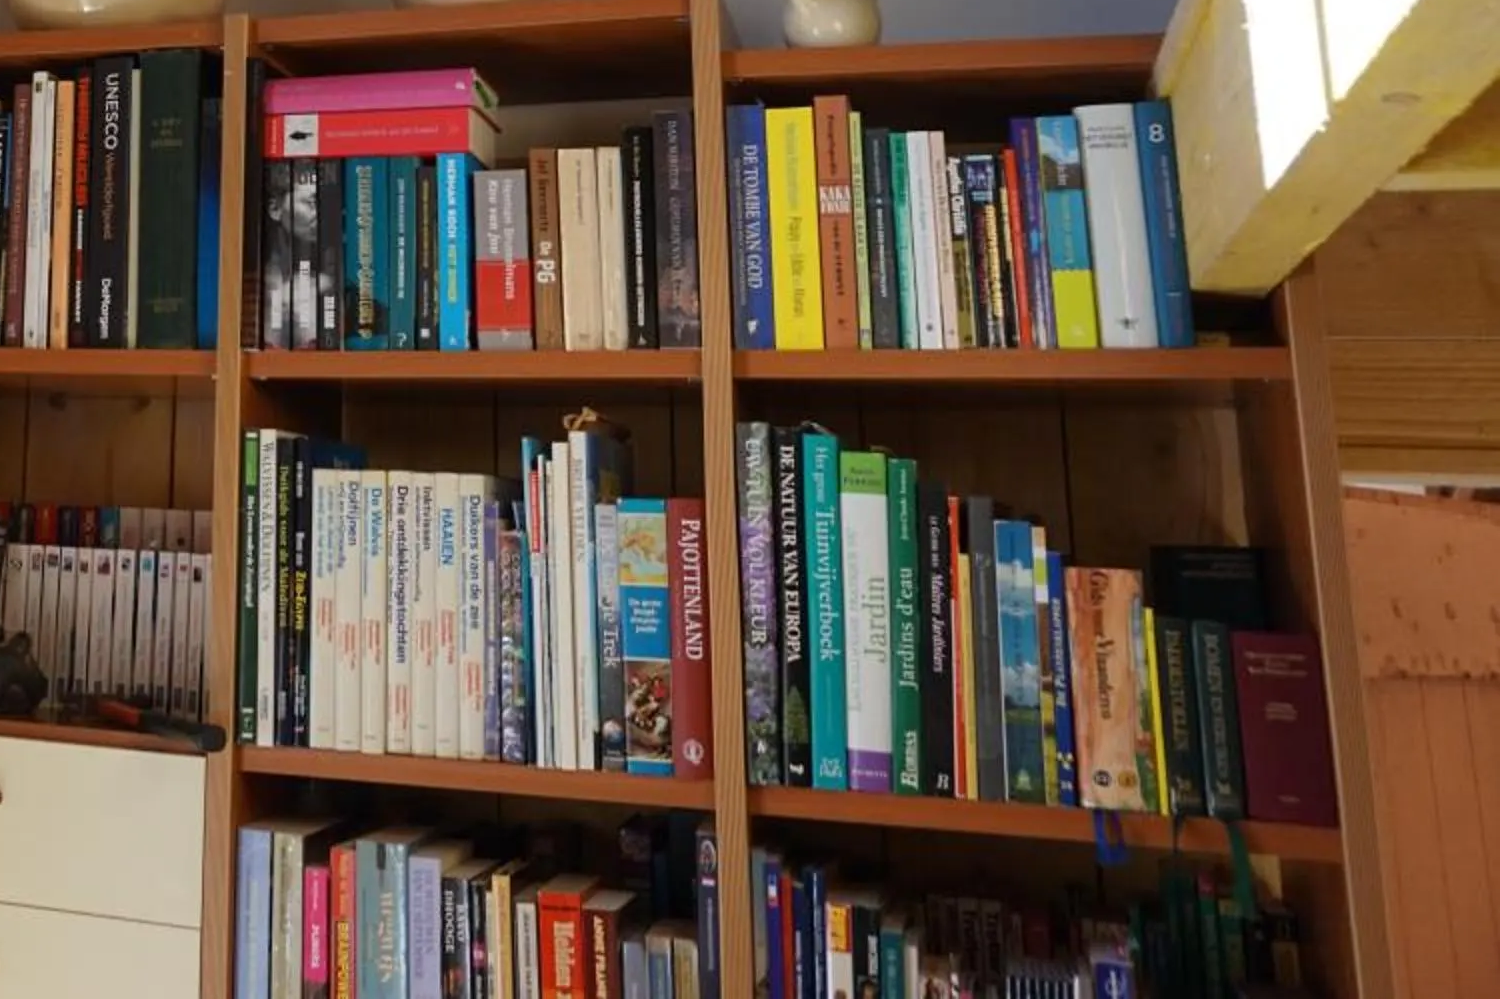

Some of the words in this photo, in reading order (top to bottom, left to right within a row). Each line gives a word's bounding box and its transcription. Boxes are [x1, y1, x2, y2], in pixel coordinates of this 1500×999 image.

[104, 73, 121, 150] UNESCO
[1148, 123, 1166, 143] 8
[743, 144, 757, 166] DE
[746, 220, 761, 252] VAN
[536, 258, 556, 284] PG
[747, 253, 763, 289] GOD
[780, 445, 795, 470] DE
[346, 481, 360, 546] Dolfijnen
[397, 485, 409, 515] Drie
[469, 495, 482, 550] Duikers
[781, 471, 797, 547] NATUUR
[441, 507, 455, 567] HAAIEN
[748, 532, 767, 576] VOL
[394, 517, 409, 664] ontdekkingstochten
[469, 553, 481, 581] van
[680, 518, 704, 661] PAJOTTENLAND
[783, 549, 799, 587] VAN
[813, 505, 839, 663] Tuinvijverboek
[896, 567, 915, 615] d'eau
[469, 584, 481, 601] de
[749, 577, 768, 646] KLEUR
[784, 590, 801, 663] EUROPA
[862, 575, 887, 664] Jardin
[602, 628, 621, 670] Trek
[898, 623, 917, 692] Jardins
